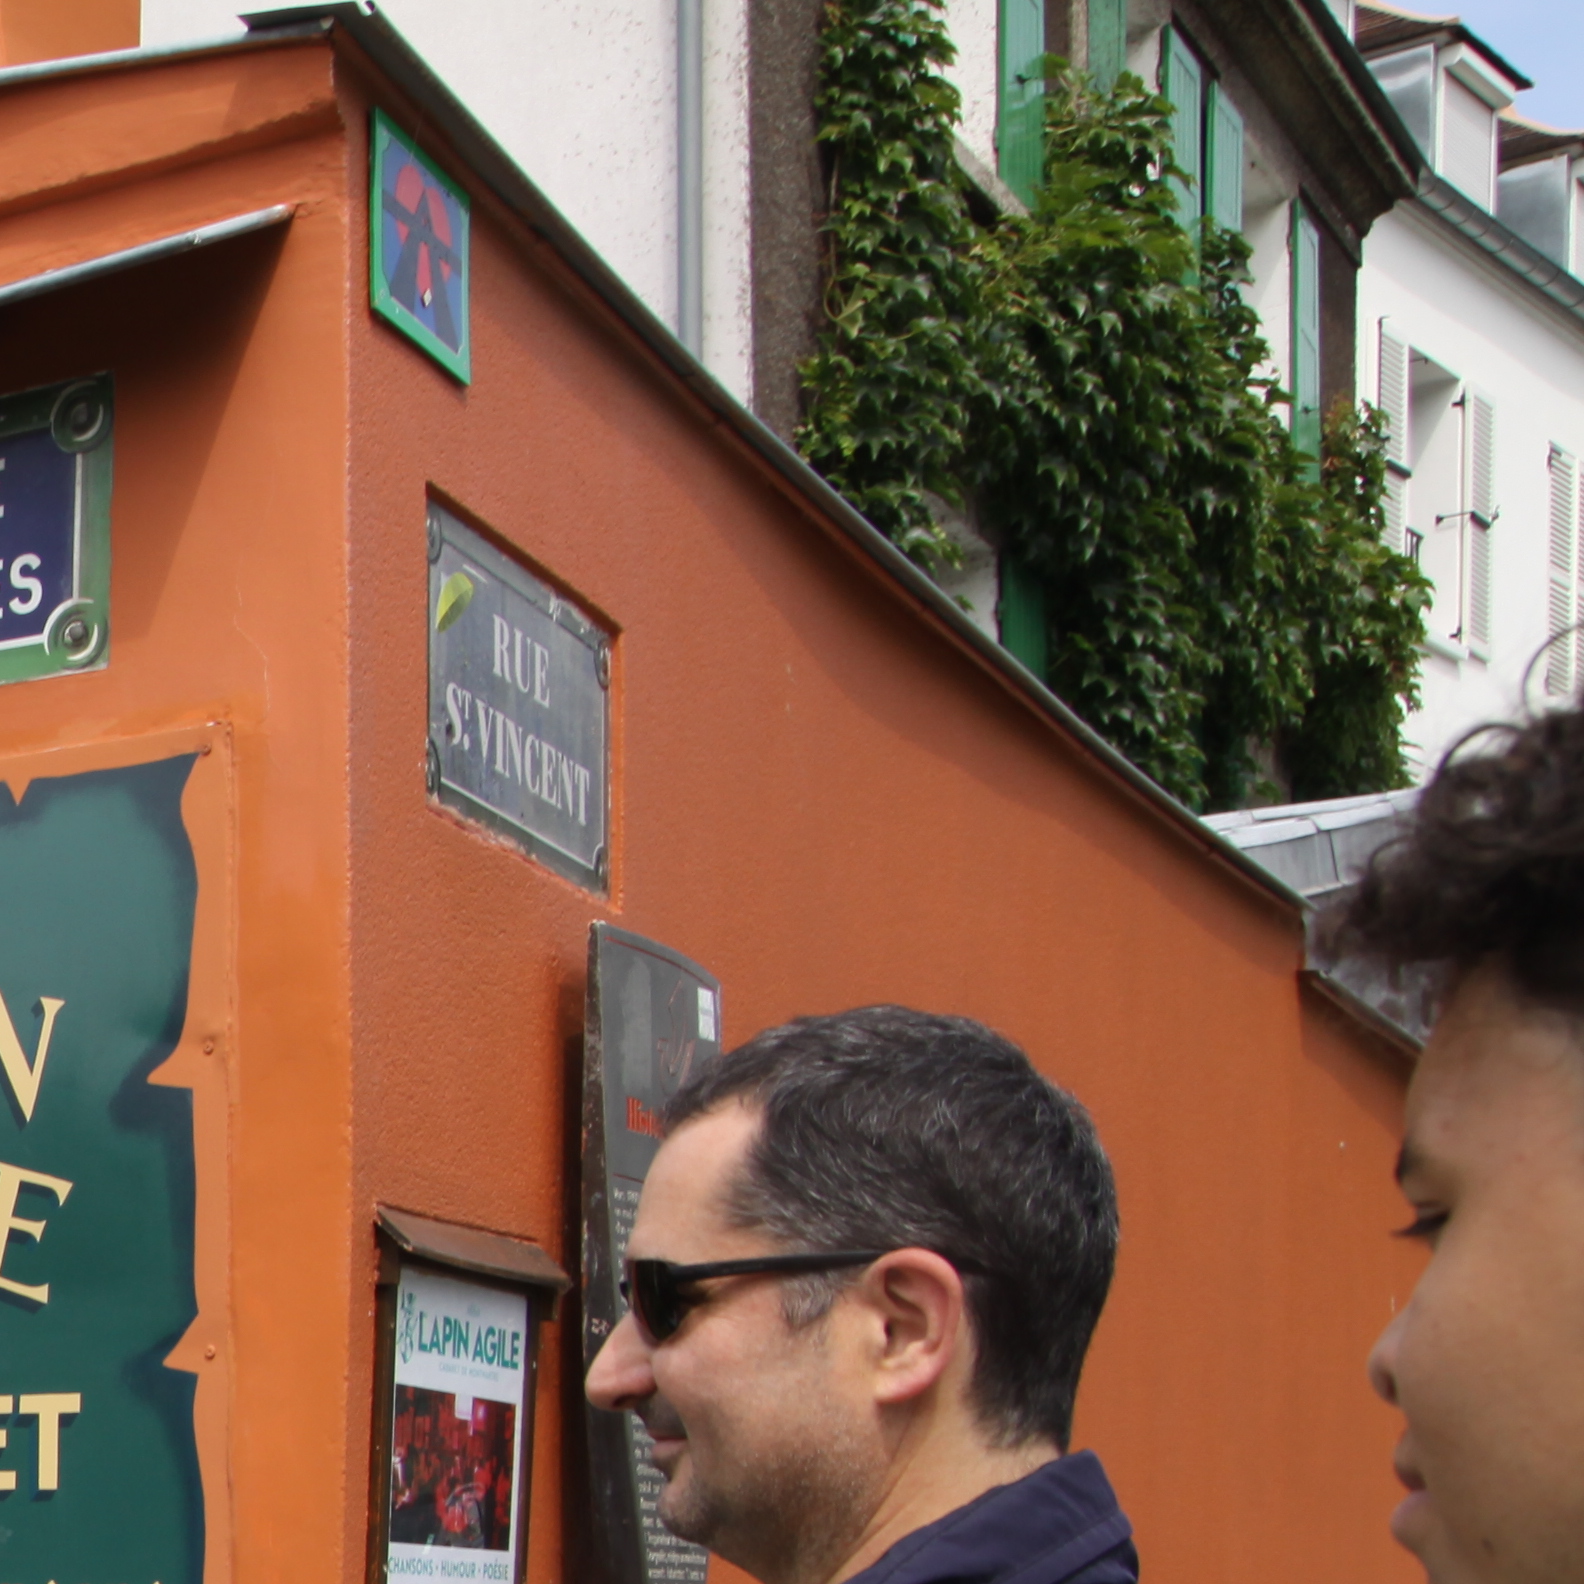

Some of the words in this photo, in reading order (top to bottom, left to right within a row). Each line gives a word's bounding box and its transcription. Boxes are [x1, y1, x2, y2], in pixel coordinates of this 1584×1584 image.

[492, 613, 550, 708] RUE
[475, 698, 591, 827] VINCENT
[418, 1310, 470, 1359] LAPIN
[472, 1325, 521, 1370] AGILE
[388, 1557, 434, 1576] CHANSONS
[441, 1560, 477, 1579] HUMOUR
[483, 1559, 509, 1581] POÉSIE
